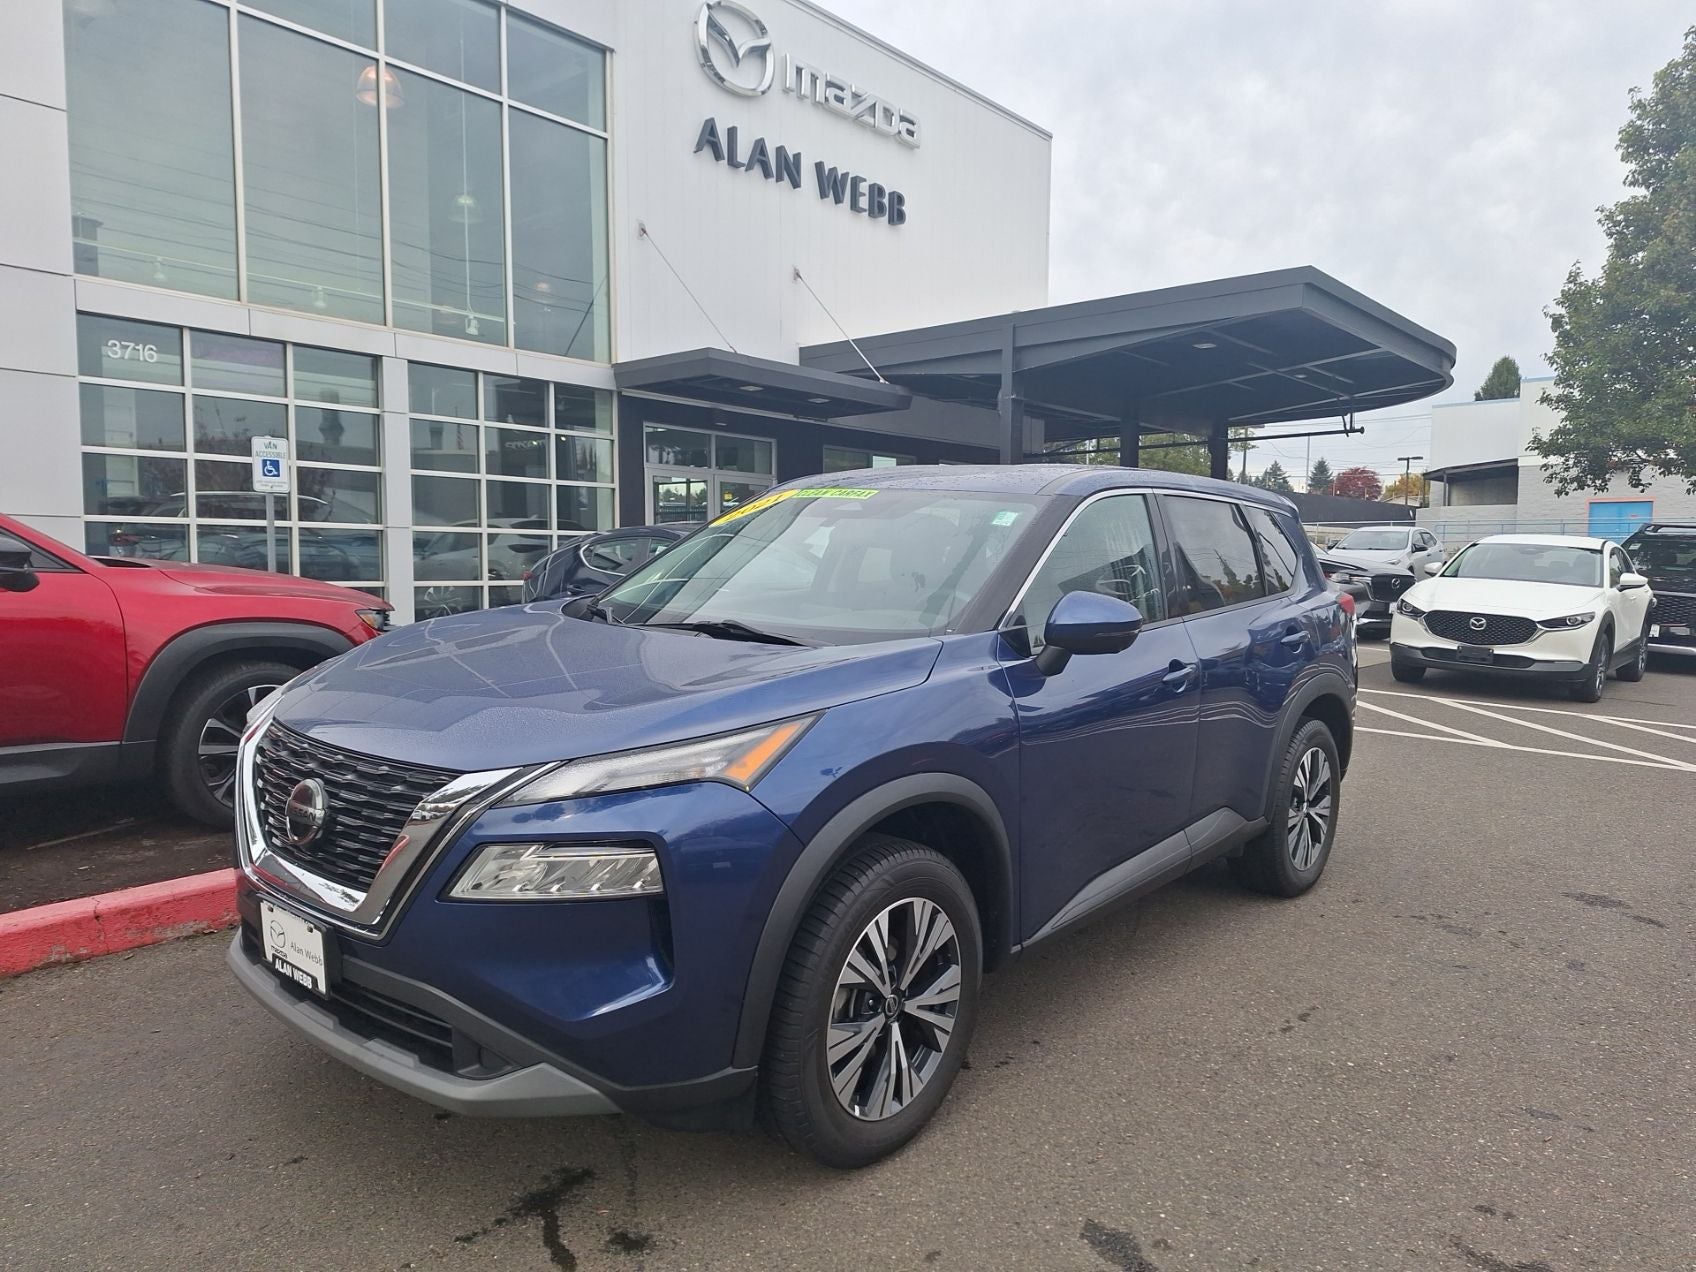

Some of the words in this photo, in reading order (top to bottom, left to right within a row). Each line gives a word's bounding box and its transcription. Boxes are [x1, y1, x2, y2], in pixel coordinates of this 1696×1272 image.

[782, 52, 920, 149] mazda
[693, 116, 801, 189] ALAN
[814, 160, 906, 226] WEBB
[107, 339, 158, 363] 3716
[256, 450, 286, 459] ACCESSIBLE
[264, 441, 277, 449] VAN
[290, 941, 304, 956] Alan
[305, 947, 324, 966] Webb
[274, 957, 293, 978] ALAN
[292, 966, 313, 989] WEBB
